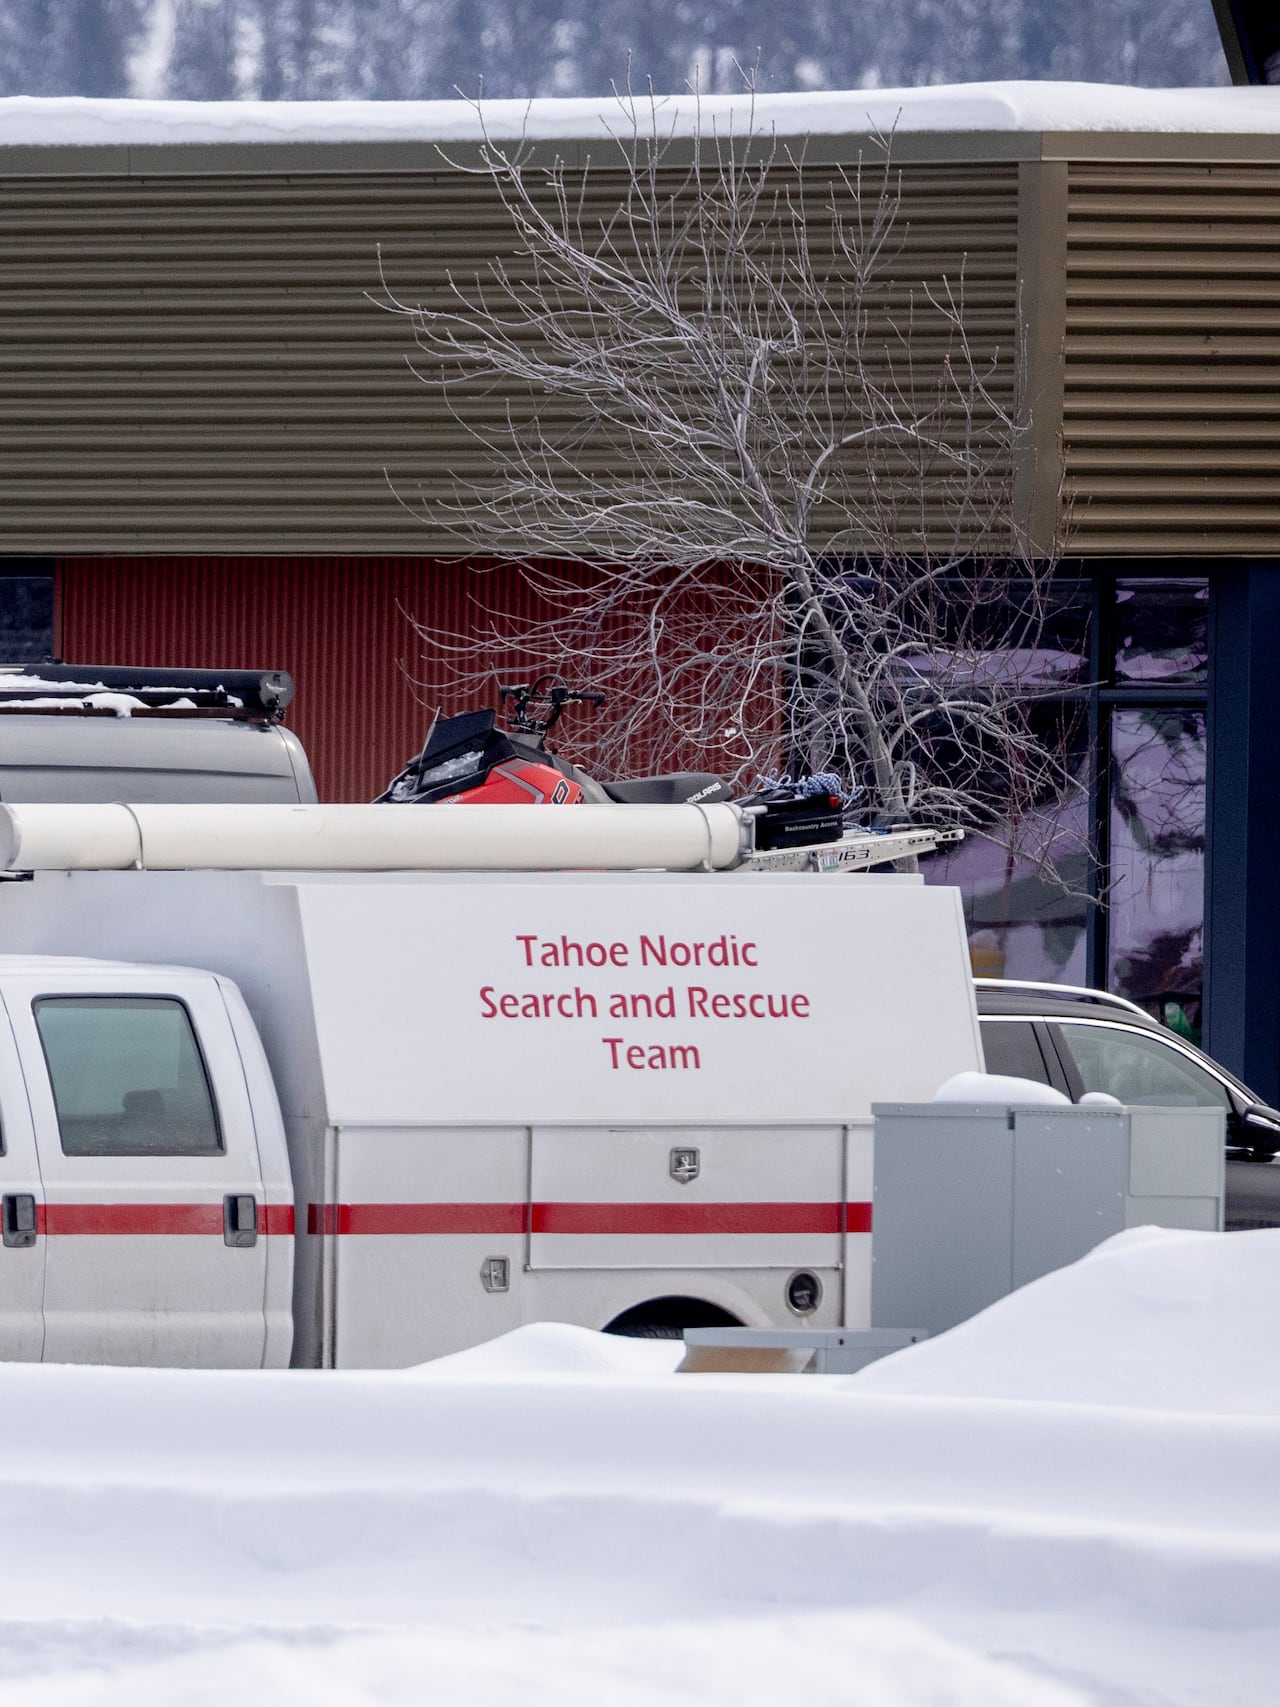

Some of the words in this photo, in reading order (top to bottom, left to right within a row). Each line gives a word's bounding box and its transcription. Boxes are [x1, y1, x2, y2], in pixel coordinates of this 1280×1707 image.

[839, 849, 870, 862] 163
[516, 935, 629, 967] Tahoe
[640, 934, 758, 967] Nordic
[479, 986, 598, 1018] Search
[609, 987, 676, 1018] and
[687, 987, 810, 1018] Rescue
[602, 1038, 701, 1070] Team
